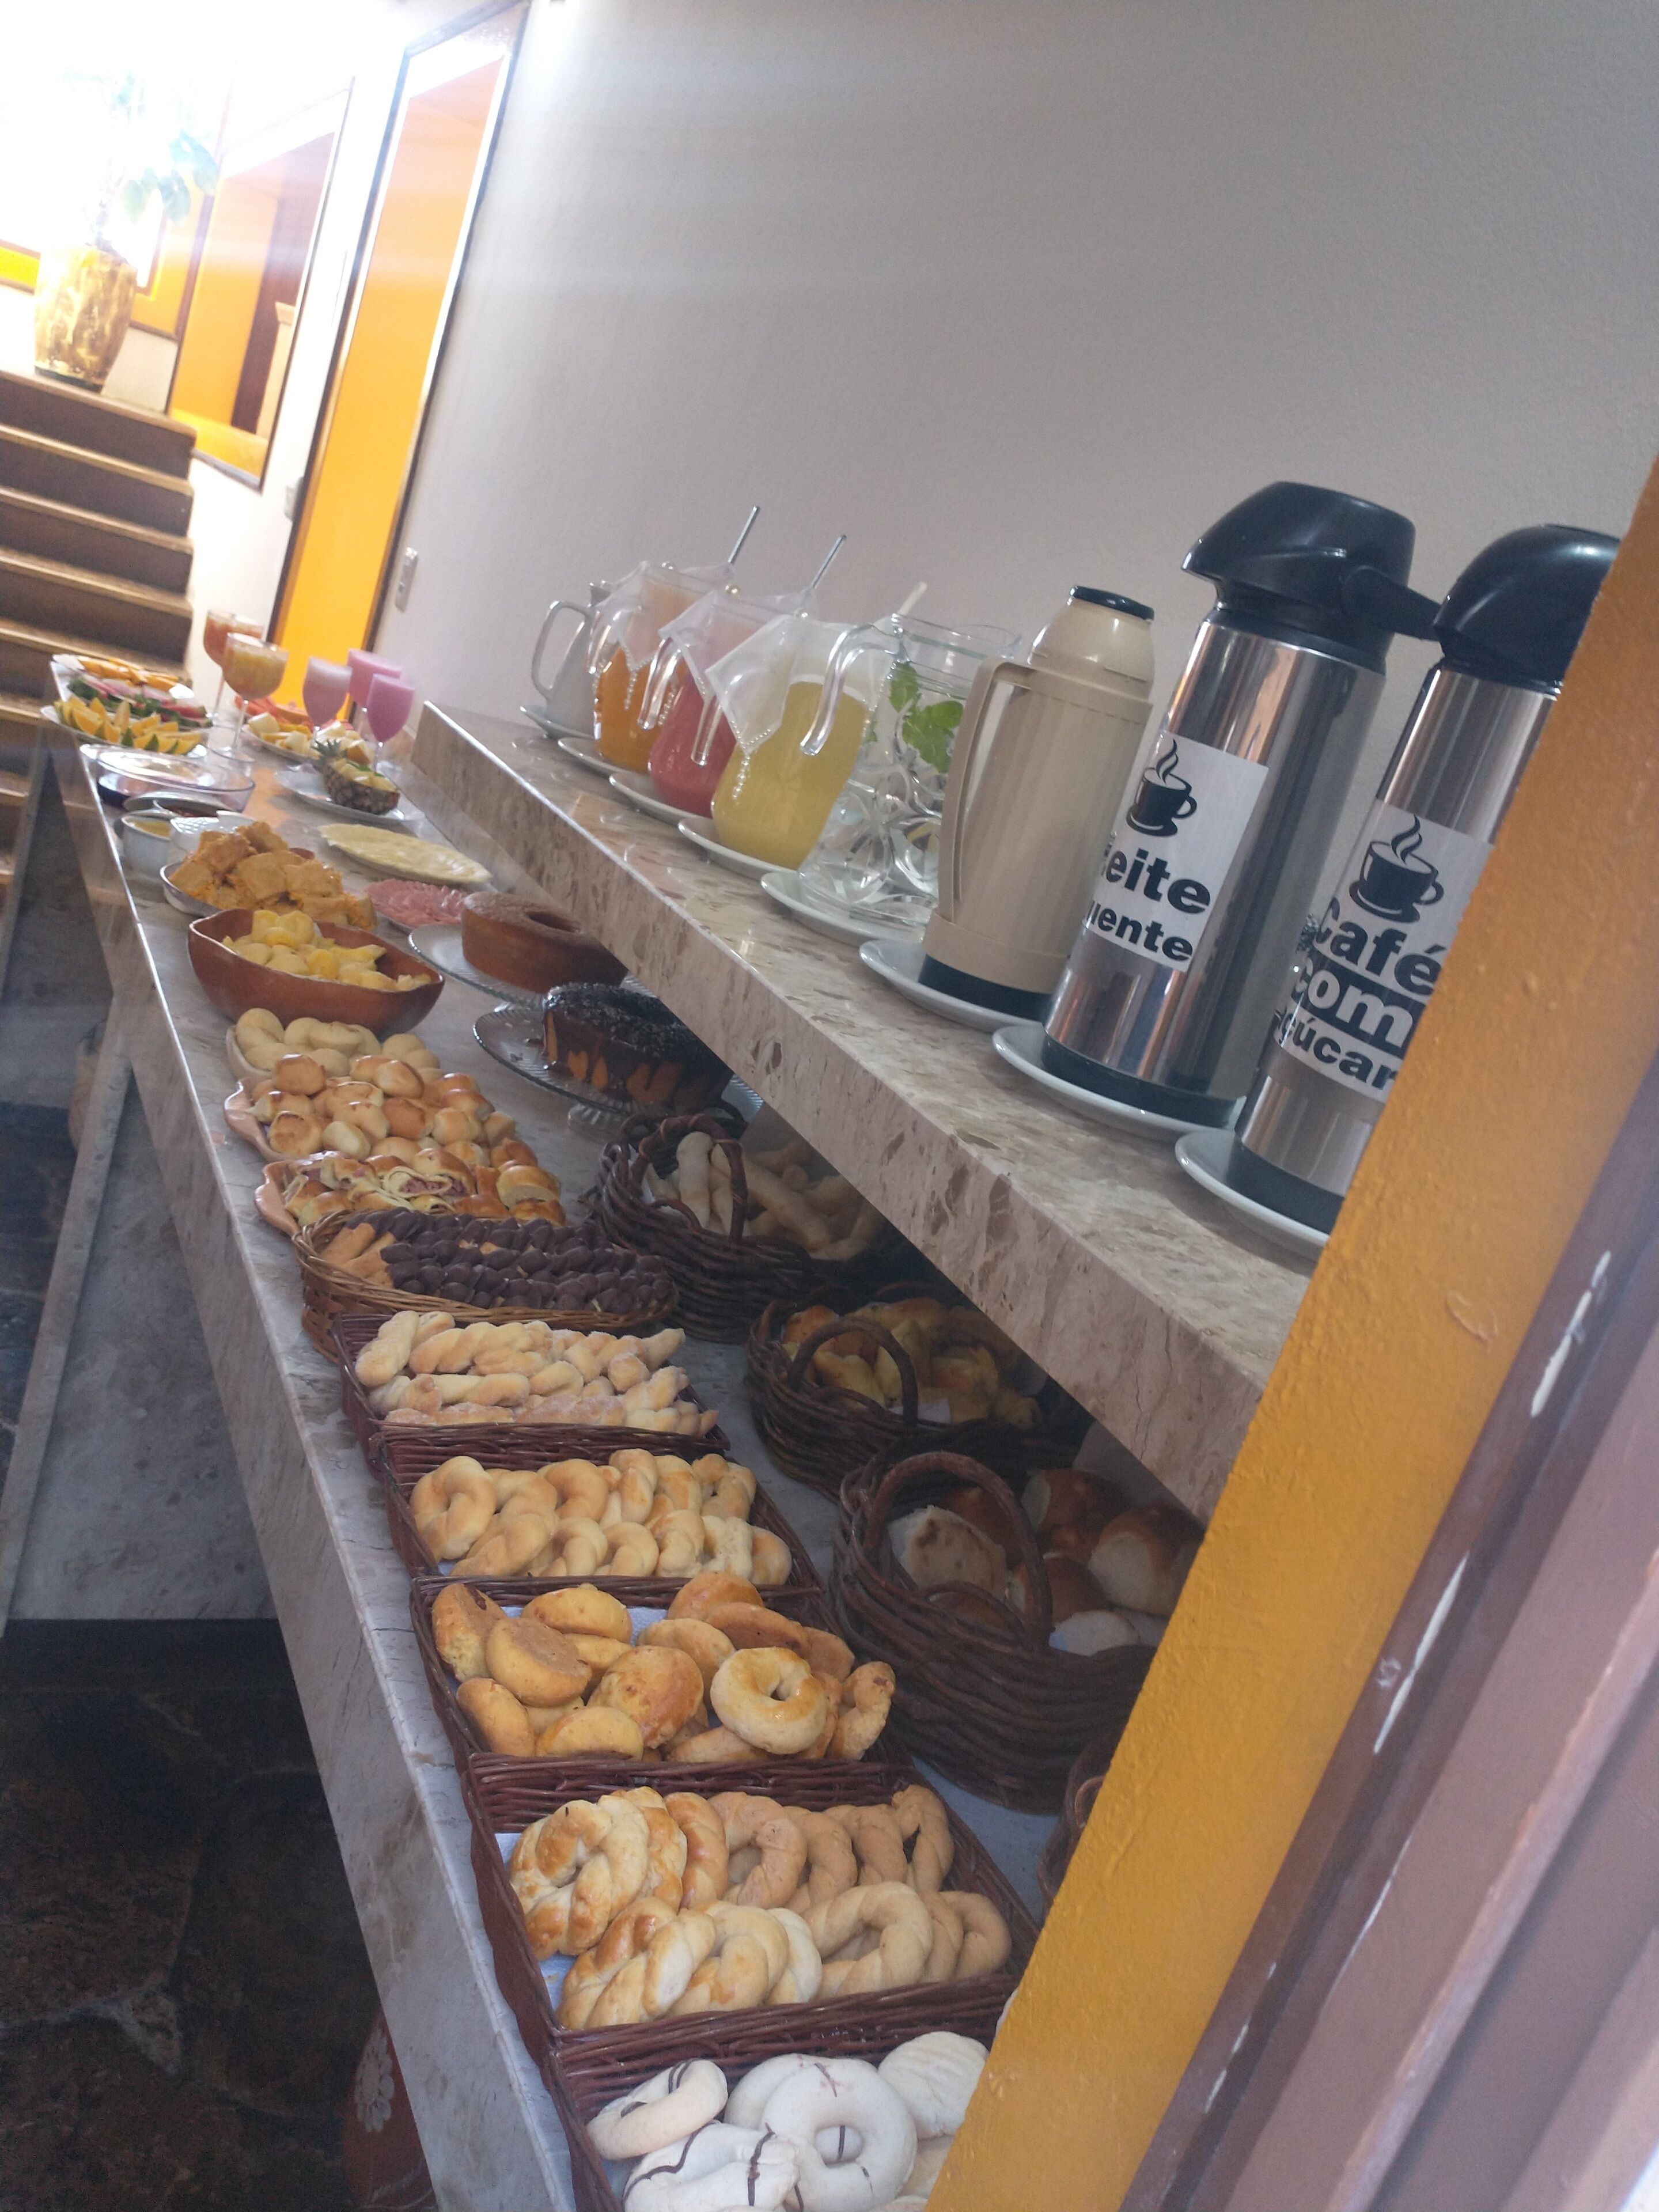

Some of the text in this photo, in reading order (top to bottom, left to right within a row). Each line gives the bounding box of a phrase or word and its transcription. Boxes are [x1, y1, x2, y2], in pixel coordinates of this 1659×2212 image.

[1101, 835, 1210, 914] eite
[1087, 900, 1192, 961] uente
[1315, 897, 1446, 995] Café
